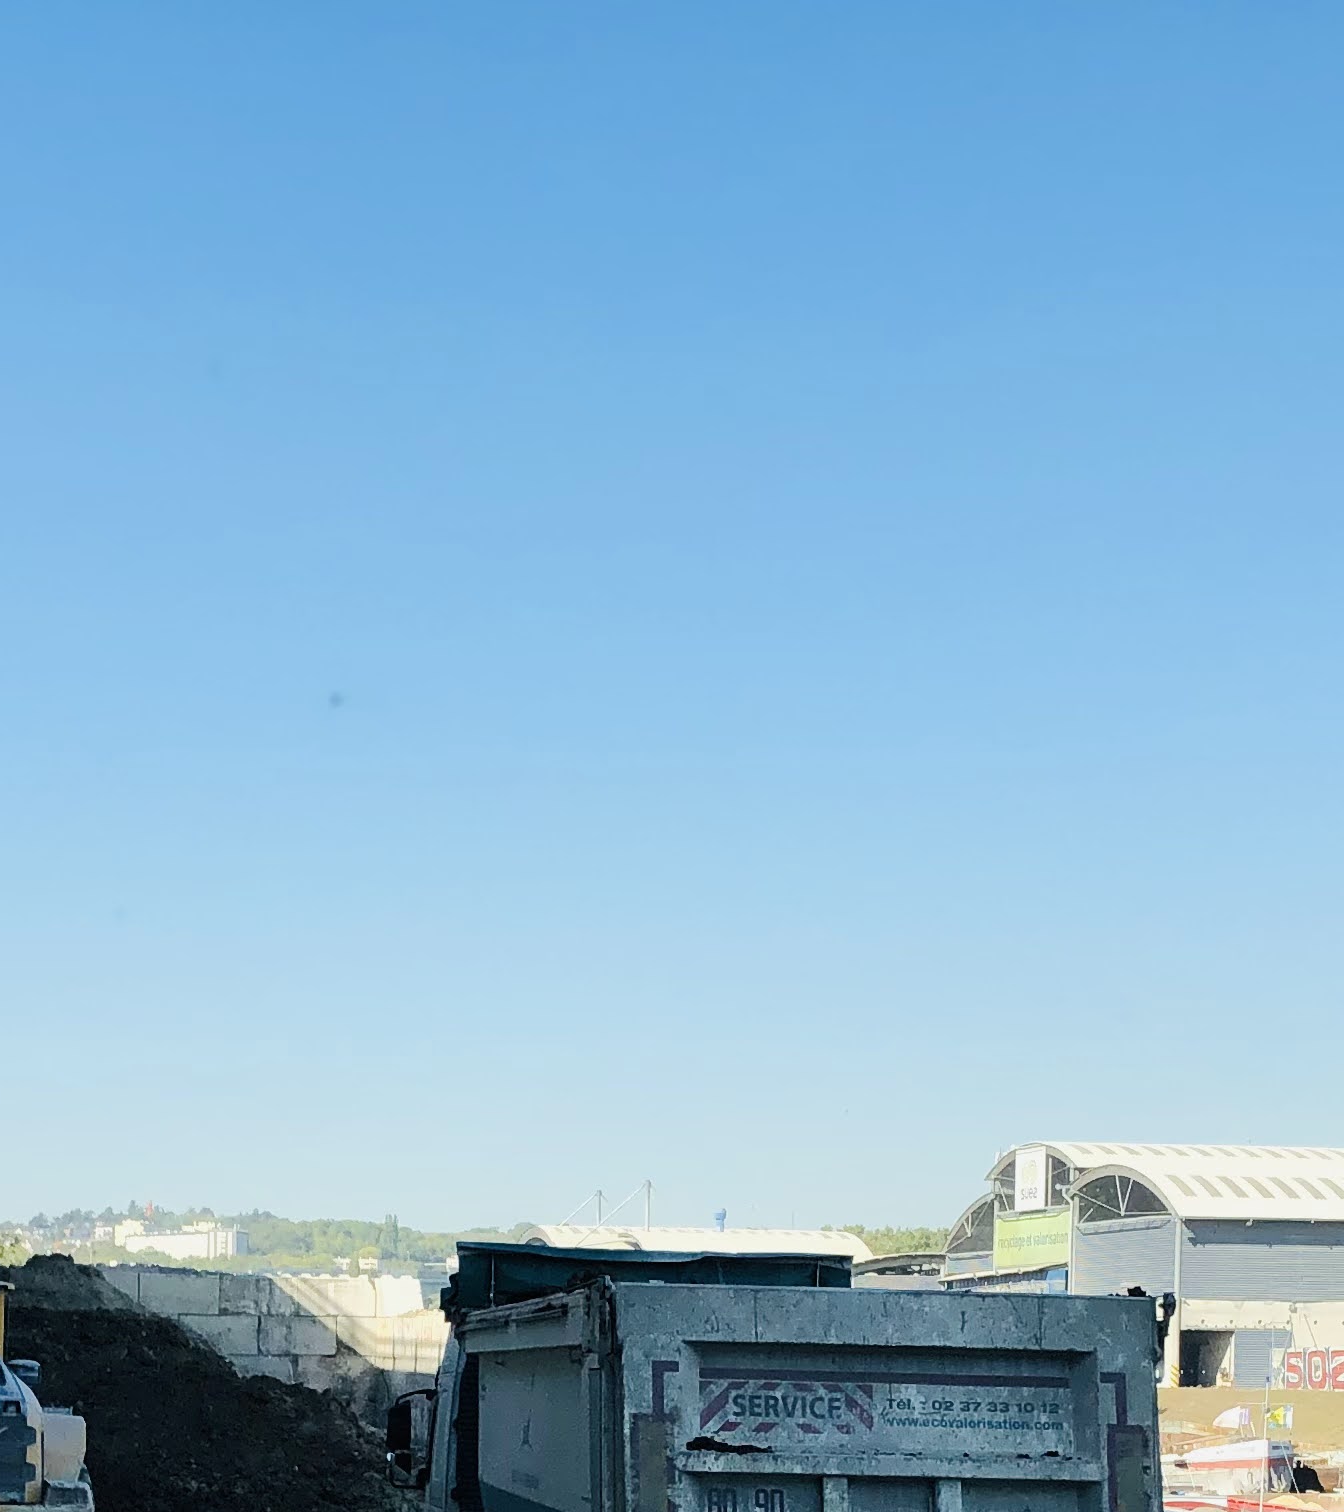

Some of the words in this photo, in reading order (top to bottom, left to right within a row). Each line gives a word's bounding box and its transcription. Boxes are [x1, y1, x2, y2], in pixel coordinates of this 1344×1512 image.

[931, 1399, 955, 1412] 02
[959, 1400, 982, 1412] 37
[986, 1401, 1010, 1413] 33
[1016, 1401, 1035, 1413] 10
[1040, 1402, 1060, 1414] 12
